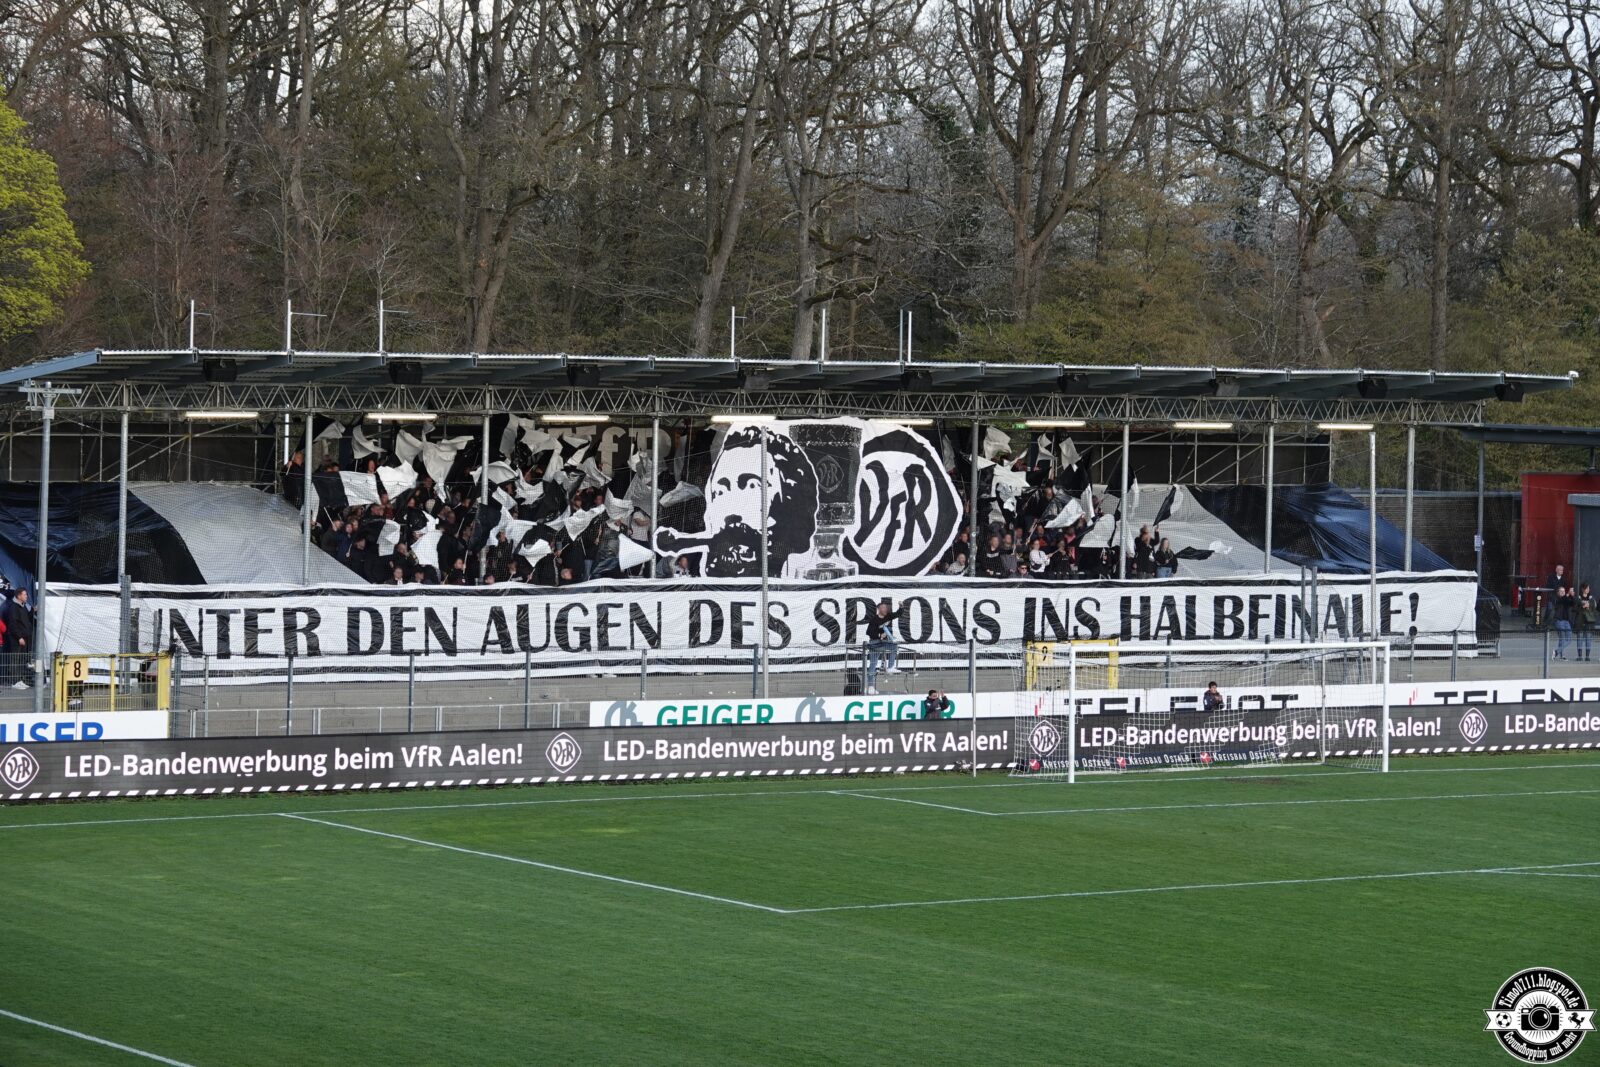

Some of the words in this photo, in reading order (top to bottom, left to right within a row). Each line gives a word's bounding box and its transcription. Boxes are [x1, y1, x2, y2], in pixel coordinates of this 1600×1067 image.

[130, 606, 321, 659] UNTER
[346, 605, 458, 657] DEN
[480, 601, 662, 655] AUGEN
[688, 599, 792, 651] DES
[1023, 596, 1101, 644] INS
[1119, 591, 1420, 643] HALBFINALE!
[1041, 645, 1049, 662] 9
[73, 660, 82, 678] 8
[1064, 694, 1298, 714] TELEOT
[656, 704, 775, 726] GEIGER
[65, 750, 327, 778] LED-Bandenwerbung
[334, 747, 394, 771] beim
[402, 745, 442, 768] VfR
[448, 742, 523, 767] Aalen!
[603, 735, 835, 763] LED-Bandenwerbung
[841, 732, 893, 755] beim
[899, 731, 937, 753] VfR
[945, 729, 1009, 752] Aalen!
[1080, 721, 1287, 748] LED-Bandenwerbung
[1292, 719, 1339, 741] beim
[1344, 718, 1378, 738] VfR
[1386, 716, 1441, 738] Aalen!
[1504, 711, 1600, 734] LED-Bande
[1042, 758, 1079, 769] KREISBU
